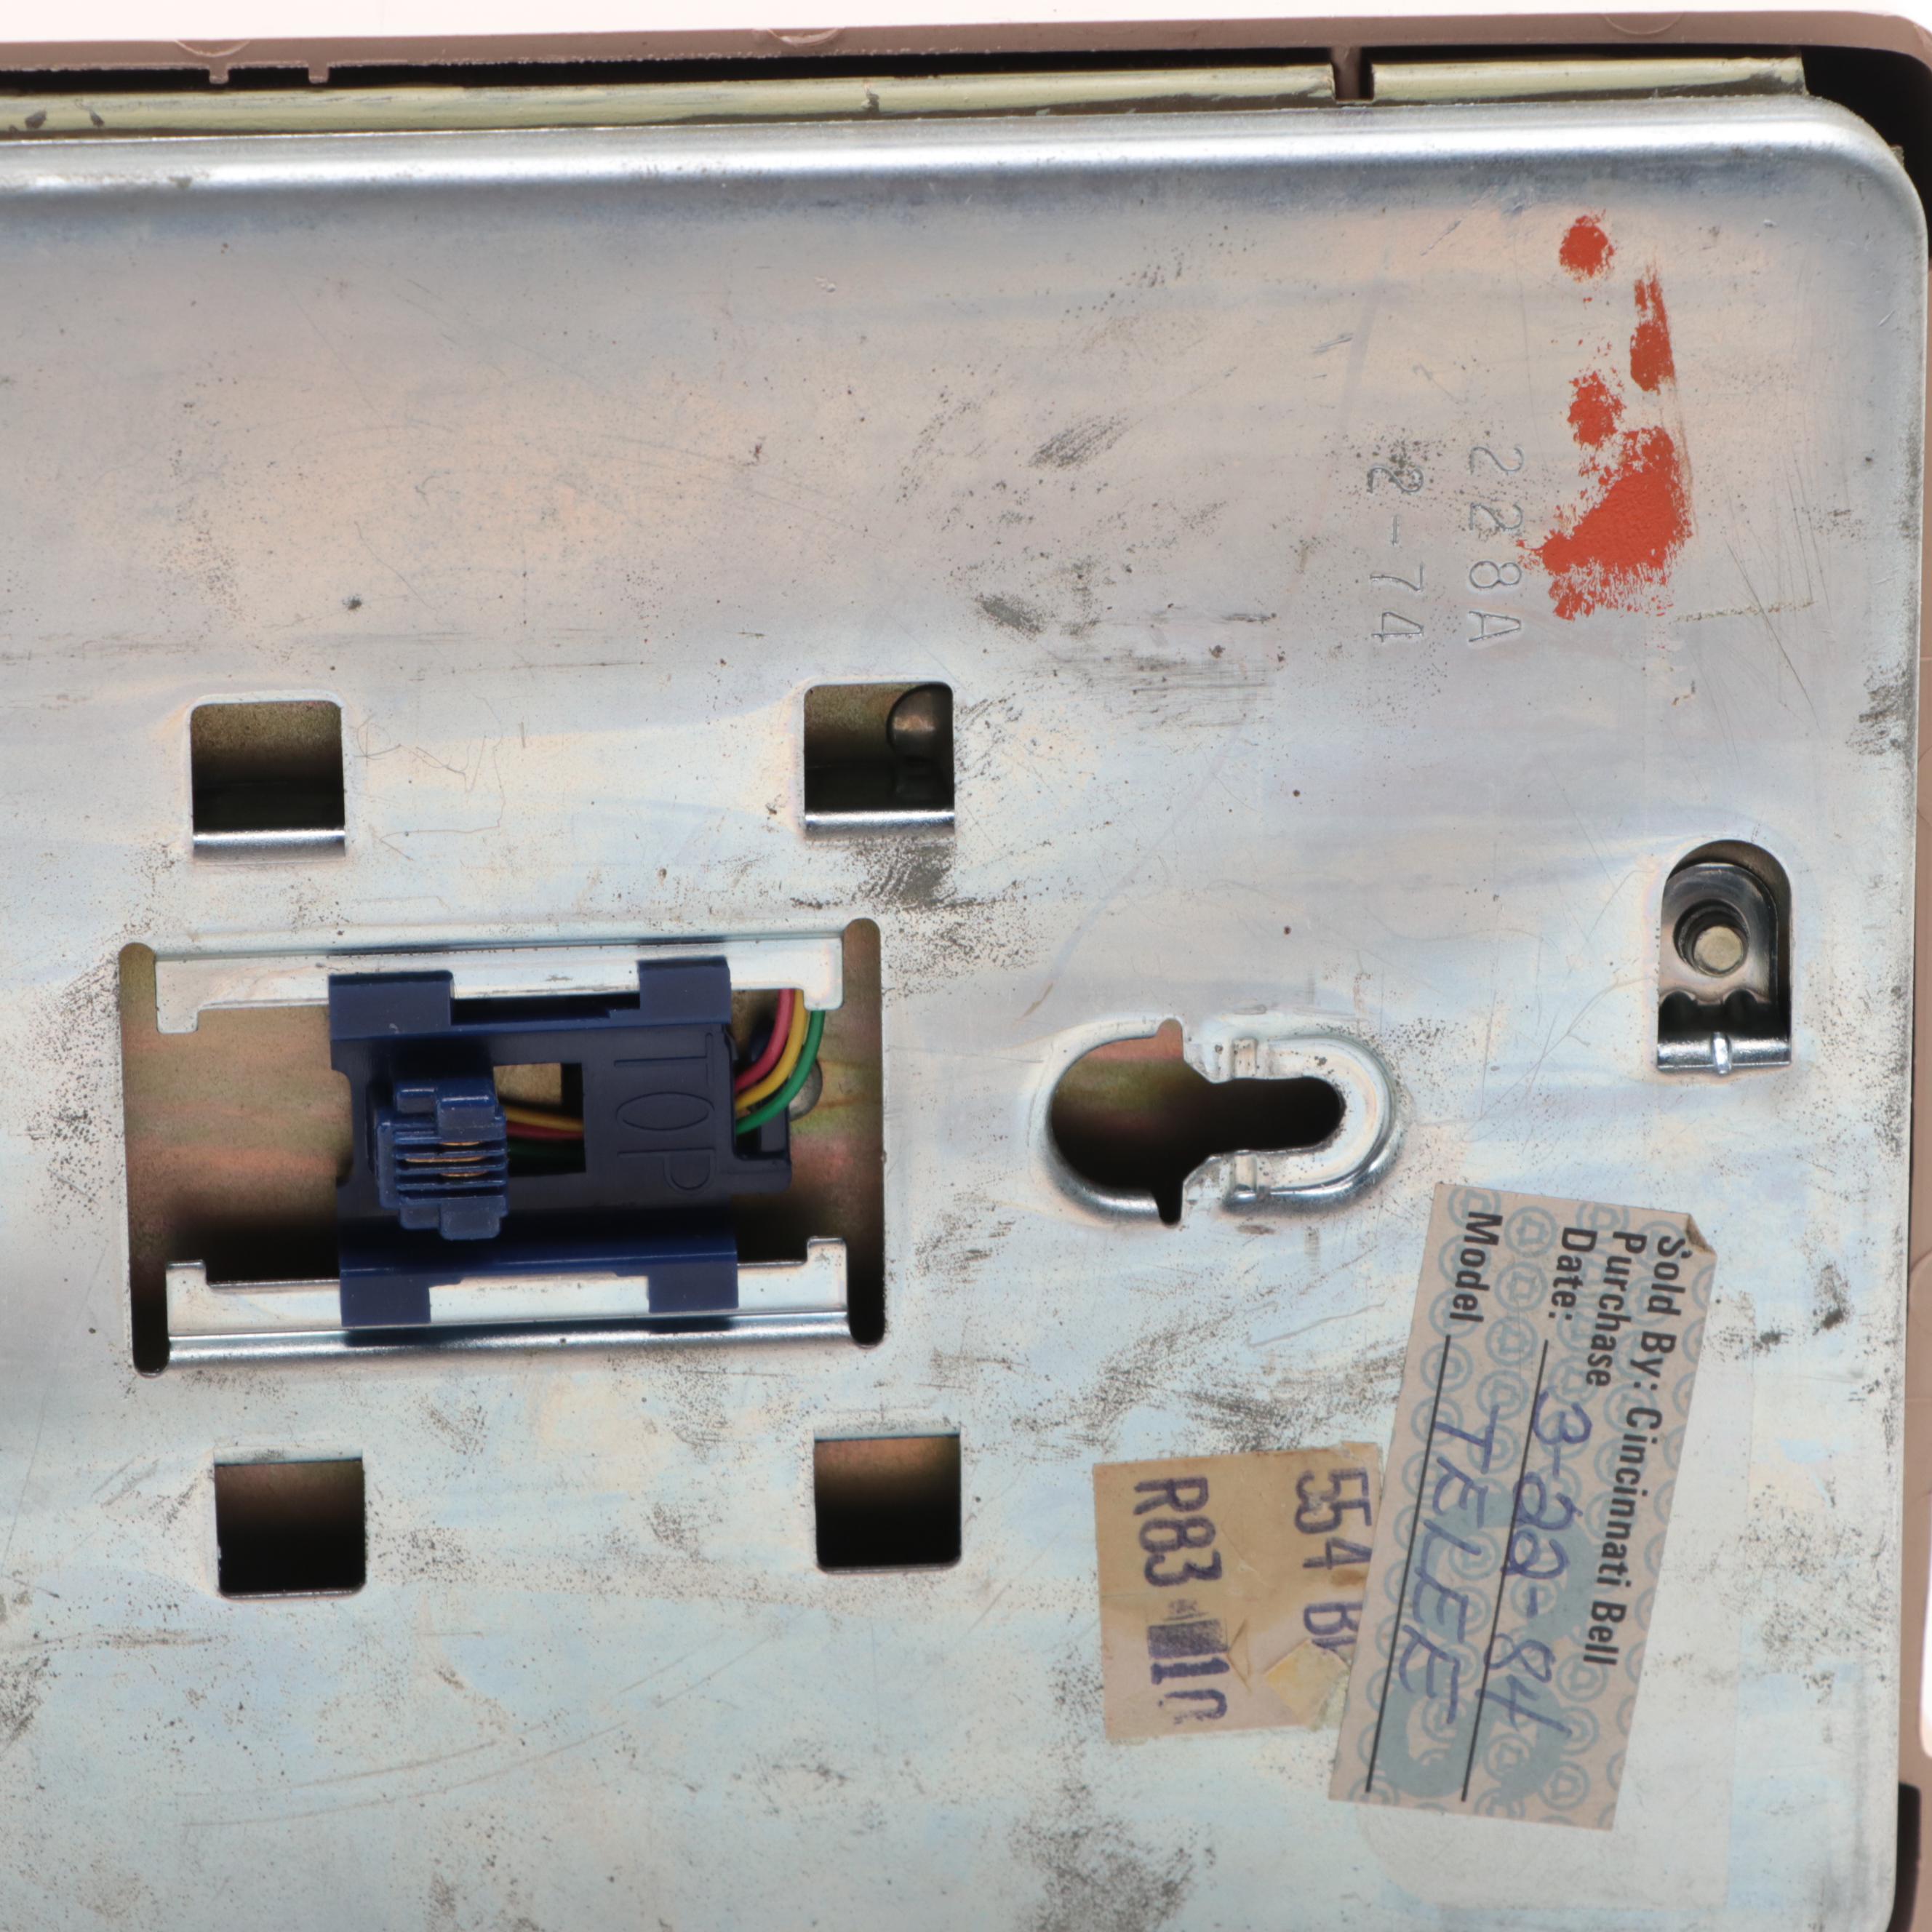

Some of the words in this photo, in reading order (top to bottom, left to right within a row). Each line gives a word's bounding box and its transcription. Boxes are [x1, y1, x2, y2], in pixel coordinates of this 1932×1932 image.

[614, 1033, 716, 1195] TOP
[1448, 1210, 1503, 1322] Model
[1548, 1226, 1596, 1321] Date:
[1586, 1231, 1645, 1387] Purchase
[1644, 1236, 1693, 1314] Sold
[1629, 1330, 1674, 1391] By:
[1133, 1477, 1222, 1588] R83
[1294, 1467, 1372, 1569] 554
[1597, 1406, 1661, 1587] Cincinnati
[1584, 1600, 1627, 1666] Bell
